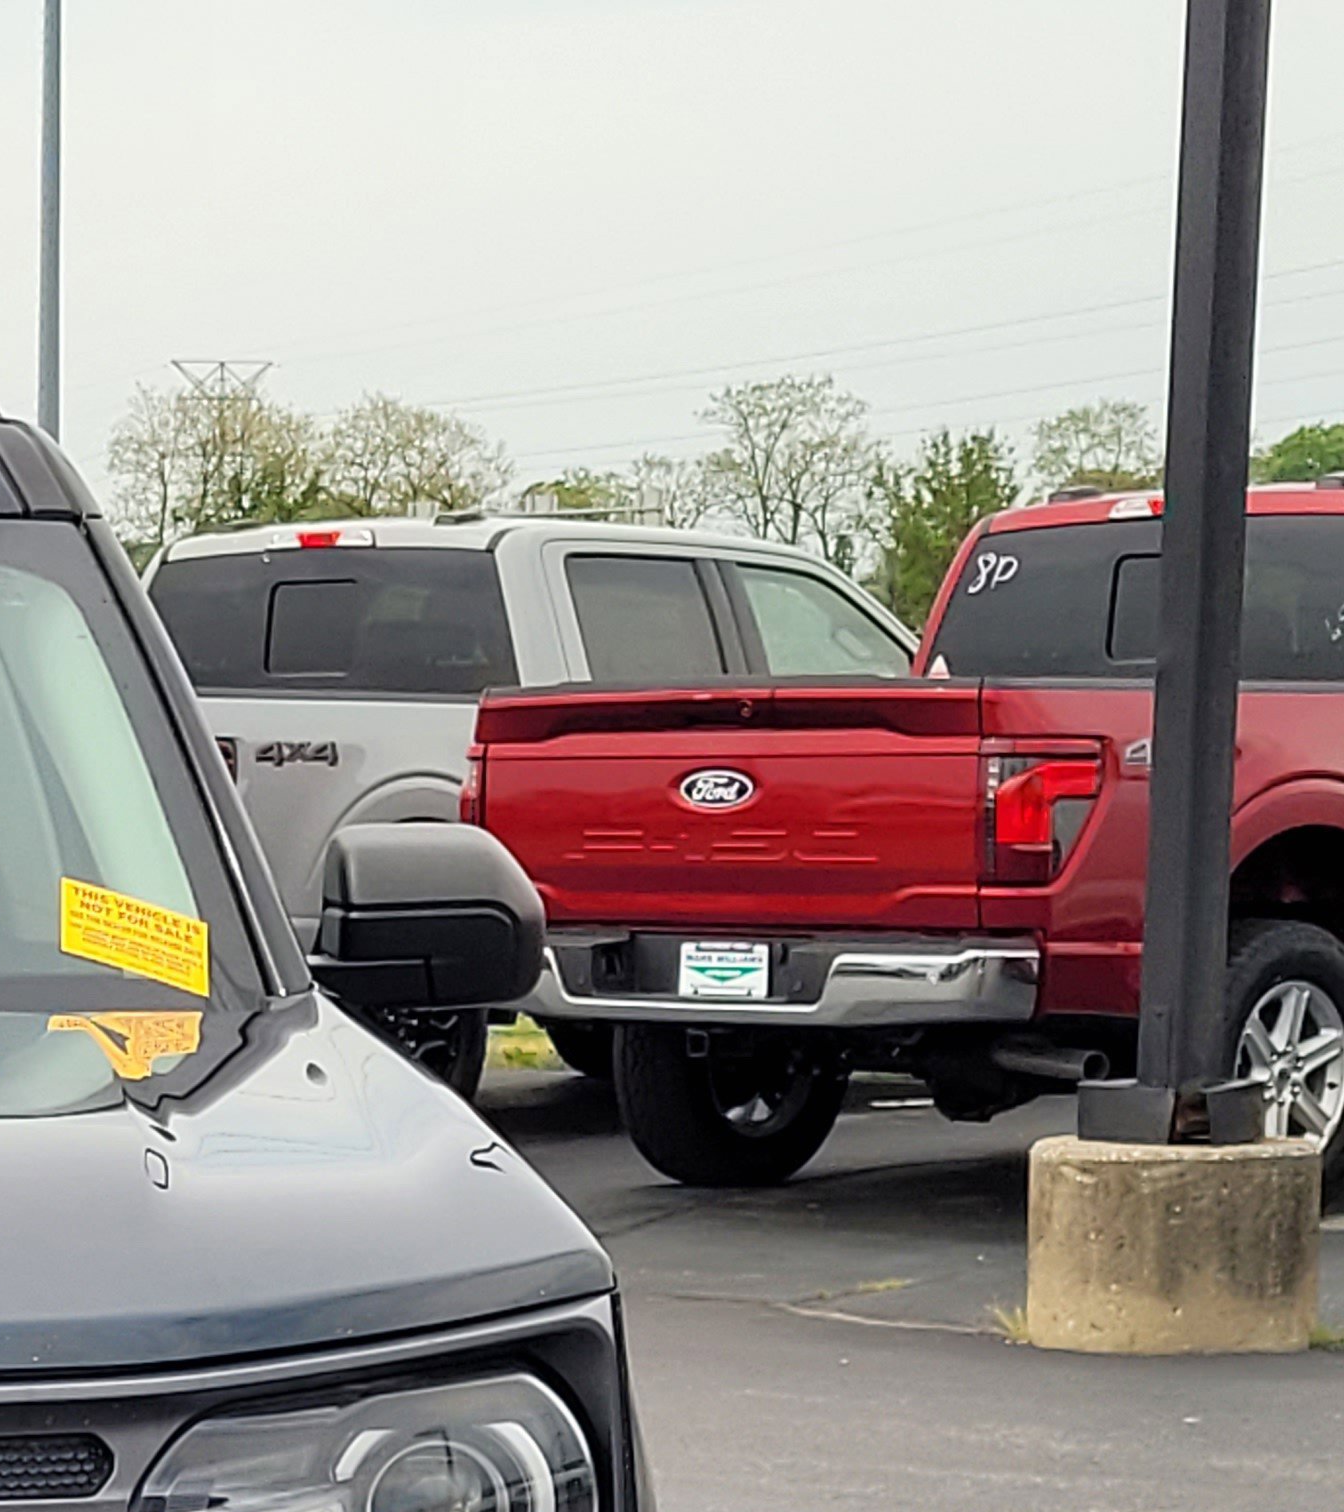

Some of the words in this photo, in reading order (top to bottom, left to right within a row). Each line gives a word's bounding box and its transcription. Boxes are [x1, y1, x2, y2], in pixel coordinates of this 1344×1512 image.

[691, 777, 741, 802] Ford
[73, 886, 110, 905] THIS
[114, 897, 181, 927] VEHICLE
[186, 921, 201, 936] IS
[79, 900, 113, 917] NOT
[118, 911, 149, 929] FOR
[153, 923, 193, 943] SALE
